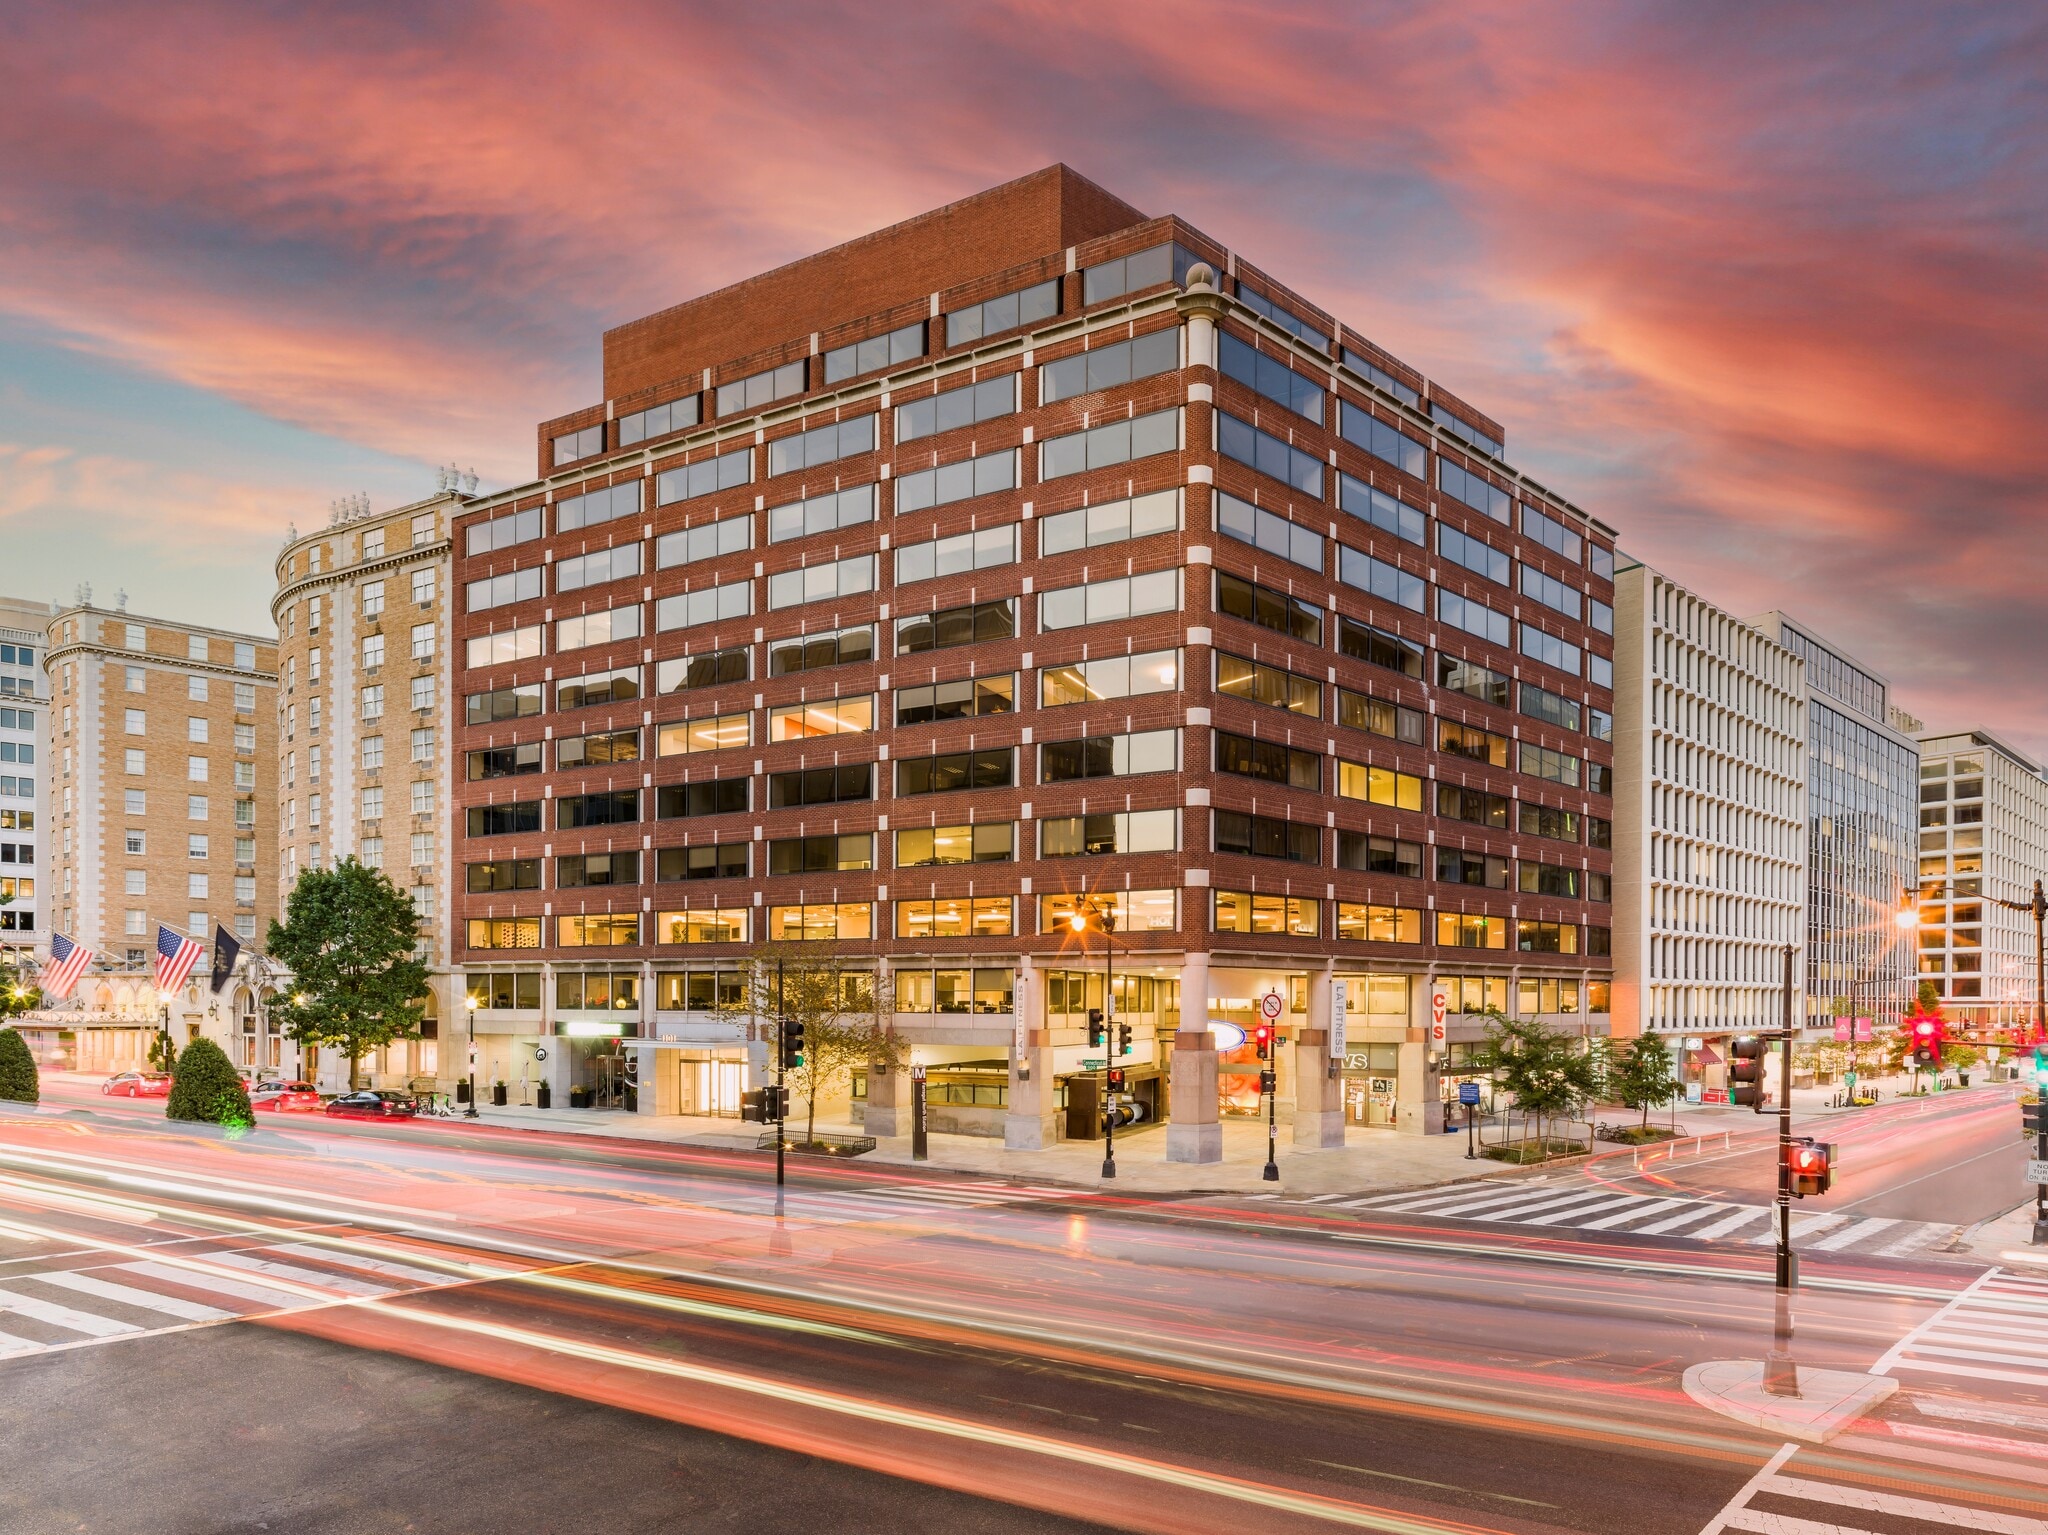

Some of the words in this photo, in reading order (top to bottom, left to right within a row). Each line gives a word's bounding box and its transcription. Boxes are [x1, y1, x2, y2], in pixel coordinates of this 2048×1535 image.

[1336, 986, 1344, 1001] LA
[1434, 994, 1445, 1039] CVS
[1335, 1006, 1344, 1053] FITNESS
[1341, 1054, 1368, 1069] VS
[915, 1068, 926, 1078] M
